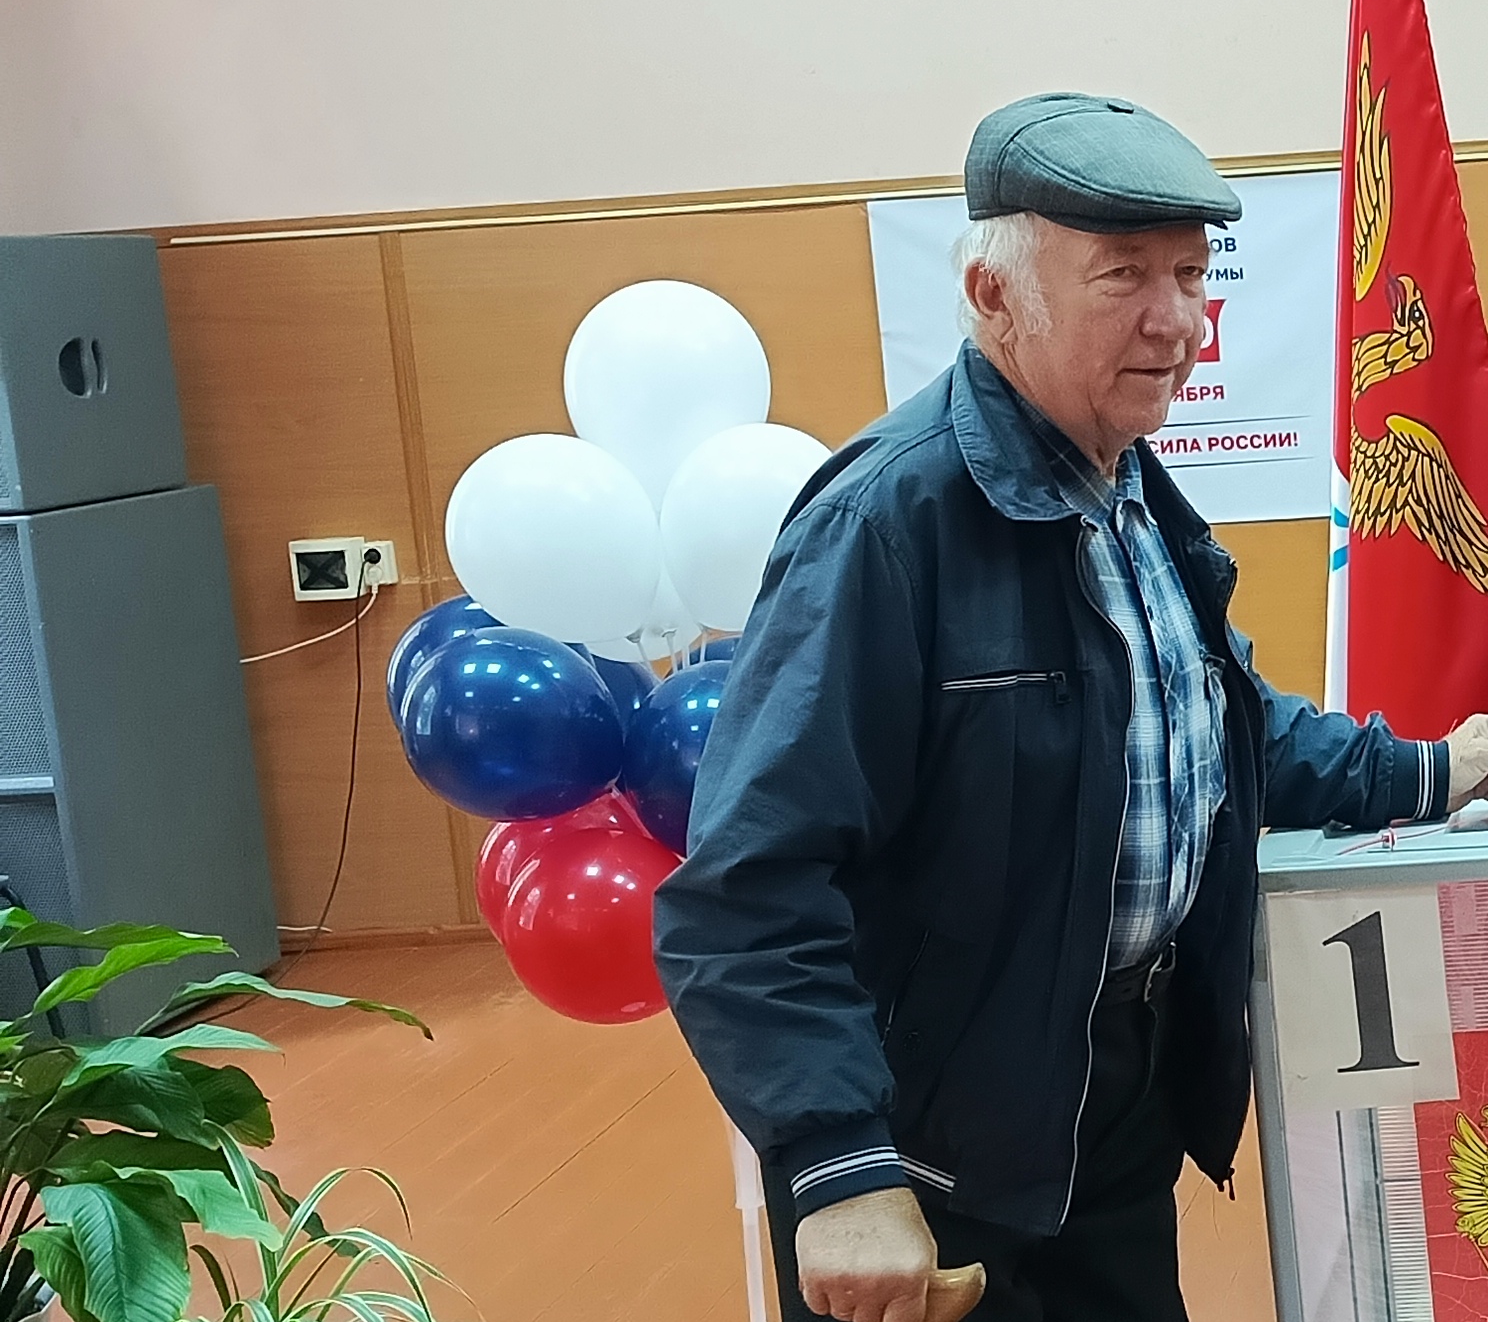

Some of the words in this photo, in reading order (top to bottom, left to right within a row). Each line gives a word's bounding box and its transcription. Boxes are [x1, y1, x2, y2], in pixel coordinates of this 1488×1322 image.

[1205, 267, 1244, 282] УМЫ
[1172, 384, 1226, 403] ЯБРЯ
[1207, 431, 1299, 452] РОССИИ!
[1322, 910, 1420, 1074] 1
